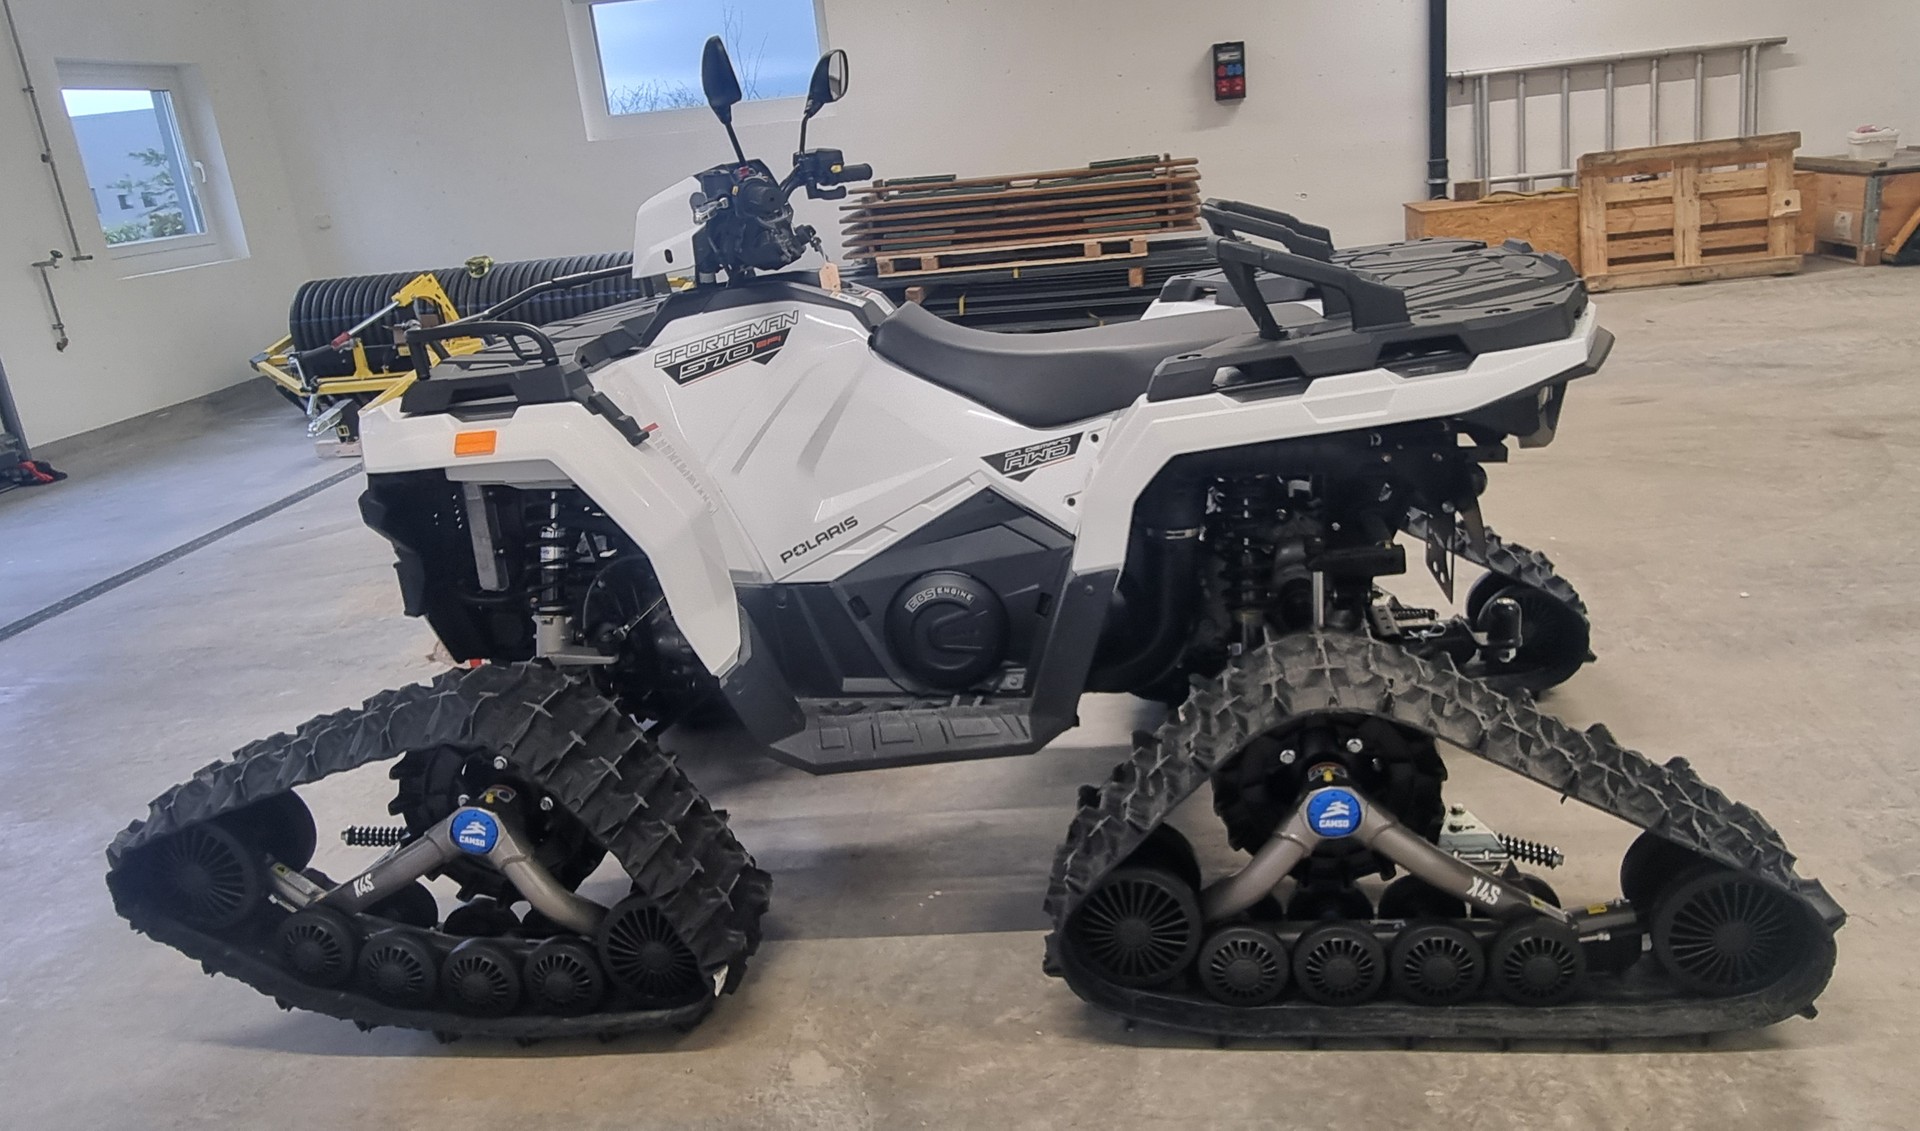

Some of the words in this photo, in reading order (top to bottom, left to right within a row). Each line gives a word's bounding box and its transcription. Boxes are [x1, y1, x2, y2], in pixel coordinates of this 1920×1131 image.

[654, 310, 799, 368] SPORTSMAN
[679, 341, 754, 379] 570
[1004, 443, 1071, 472] AWD
[1005, 449, 1021, 458] ON
[1025, 437, 1071, 453] DEMAND
[780, 516, 858, 563] POLARIS
[937, 587, 973, 601] ENGINE
[1319, 819, 1349, 828] CAMSO
[459, 835, 486, 847] CAMSO
